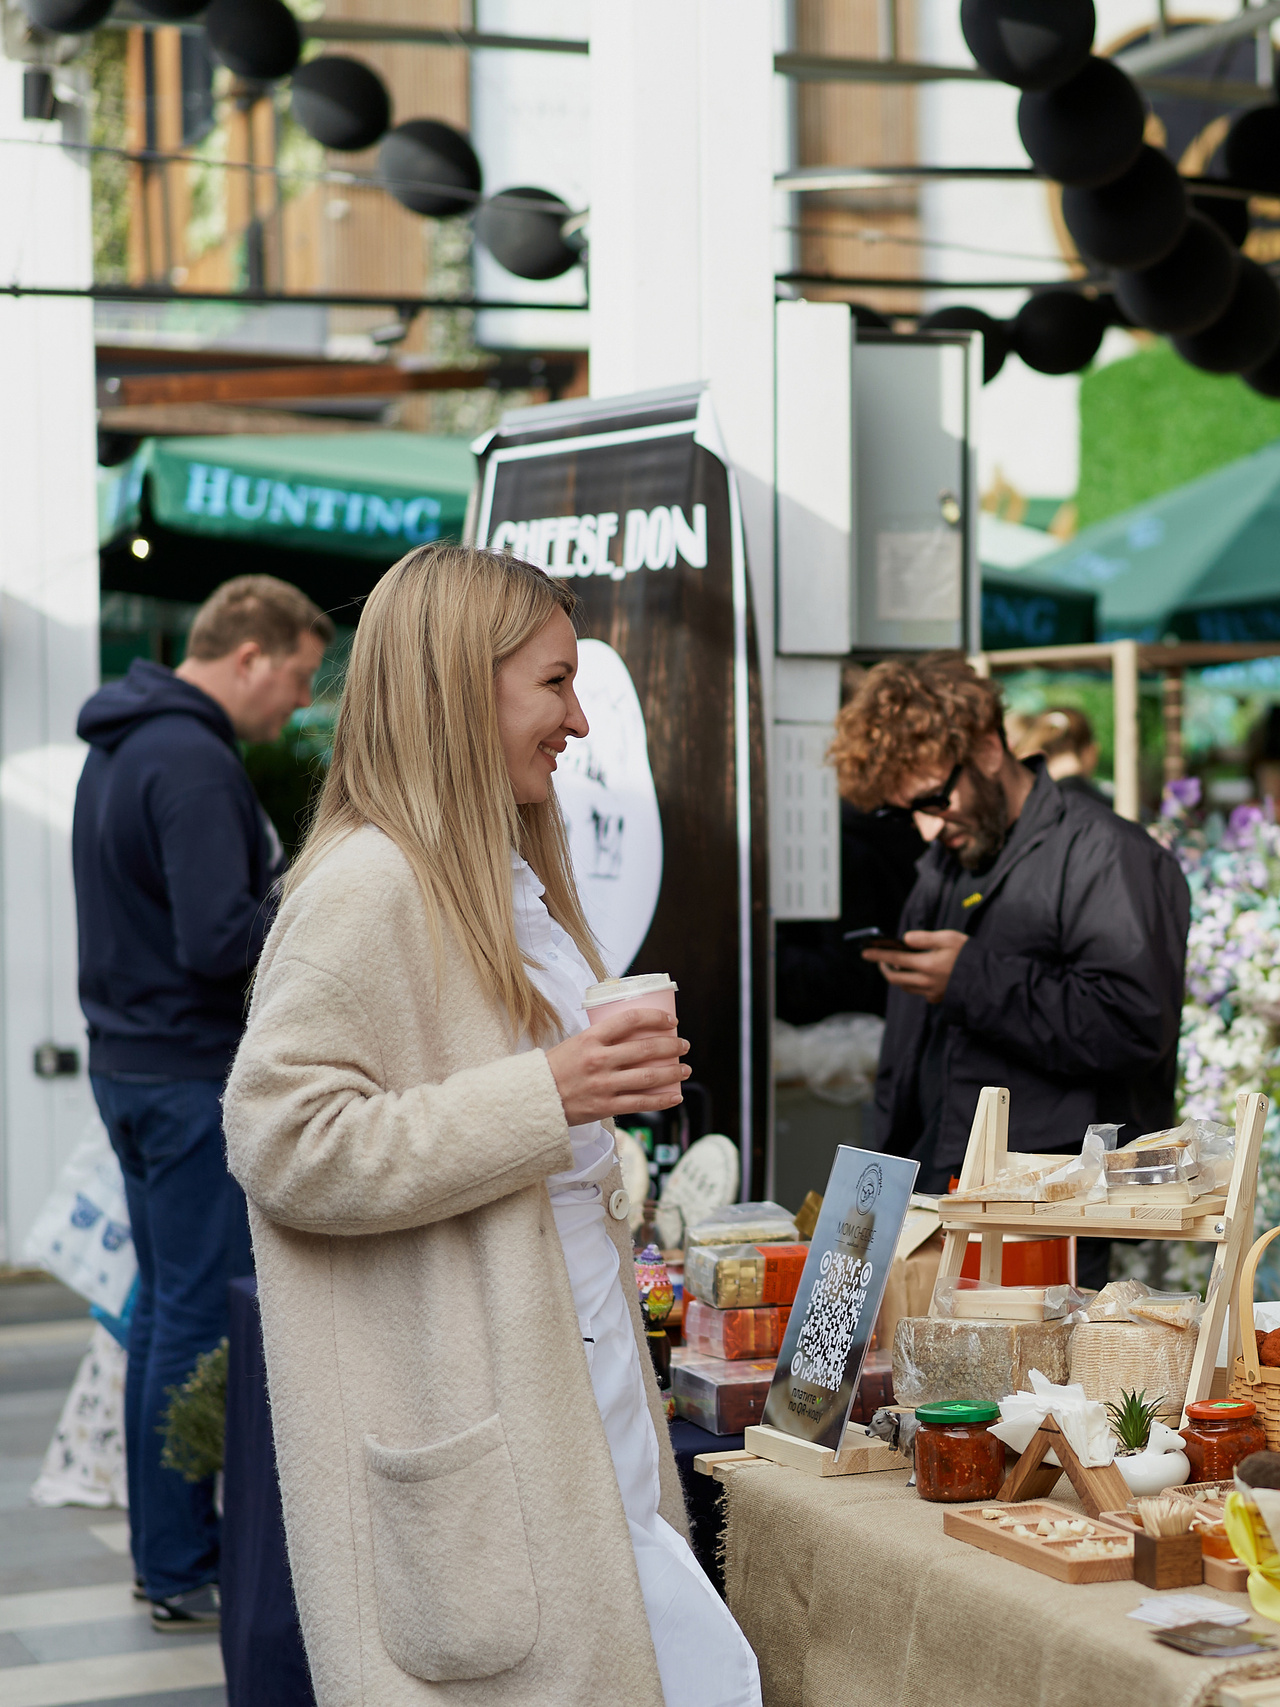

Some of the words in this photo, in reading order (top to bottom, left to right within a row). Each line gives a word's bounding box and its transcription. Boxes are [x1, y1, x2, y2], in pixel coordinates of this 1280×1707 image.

[185, 462, 441, 544] HUNTING
[836, 1221, 855, 1236] MOM
[854, 1226, 877, 1243] CHEESE
[792, 1387, 817, 1405] платите
[788, 1401, 796, 1412] по
[797, 1402, 824, 1424] QR-коду
